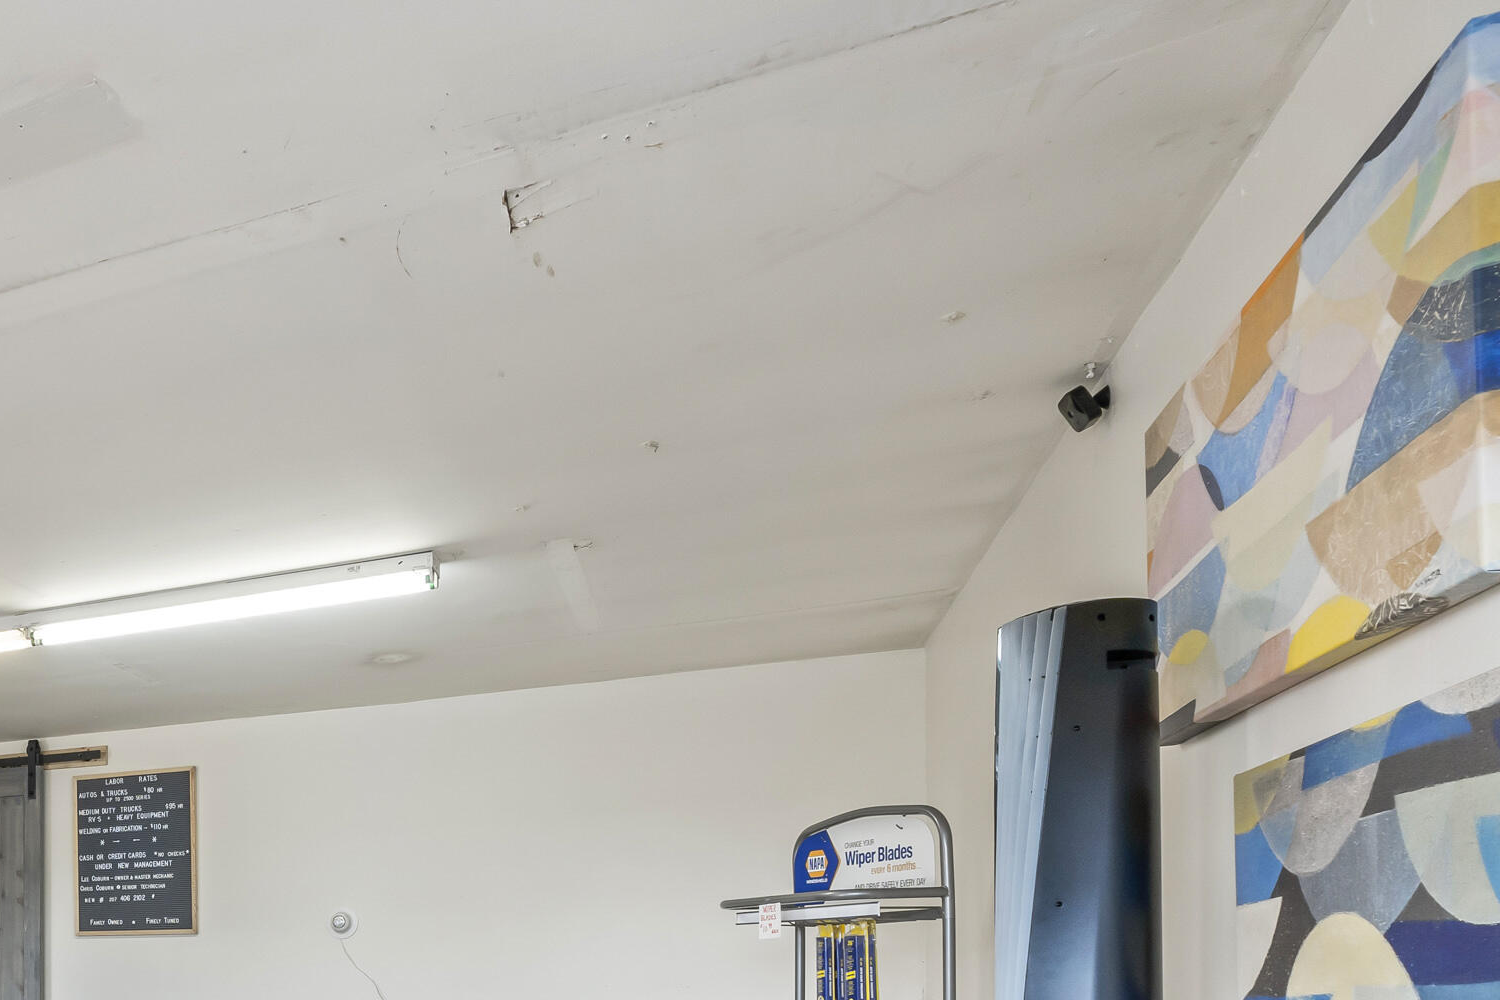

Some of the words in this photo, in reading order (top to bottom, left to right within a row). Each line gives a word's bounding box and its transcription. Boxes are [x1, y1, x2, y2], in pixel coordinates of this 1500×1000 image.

[137, 811, 170, 819] EQUIPMENT
[110, 825, 143, 833] FABRICATION
[845, 851, 876, 867] Wiper
[878, 844, 913, 862] Blades
[809, 857, 825, 870] NAPA
[887, 864, 891, 872] 6
[892, 861, 916, 872] months
[900, 879, 915, 888] EVERY
[916, 878, 926, 886] DAY
